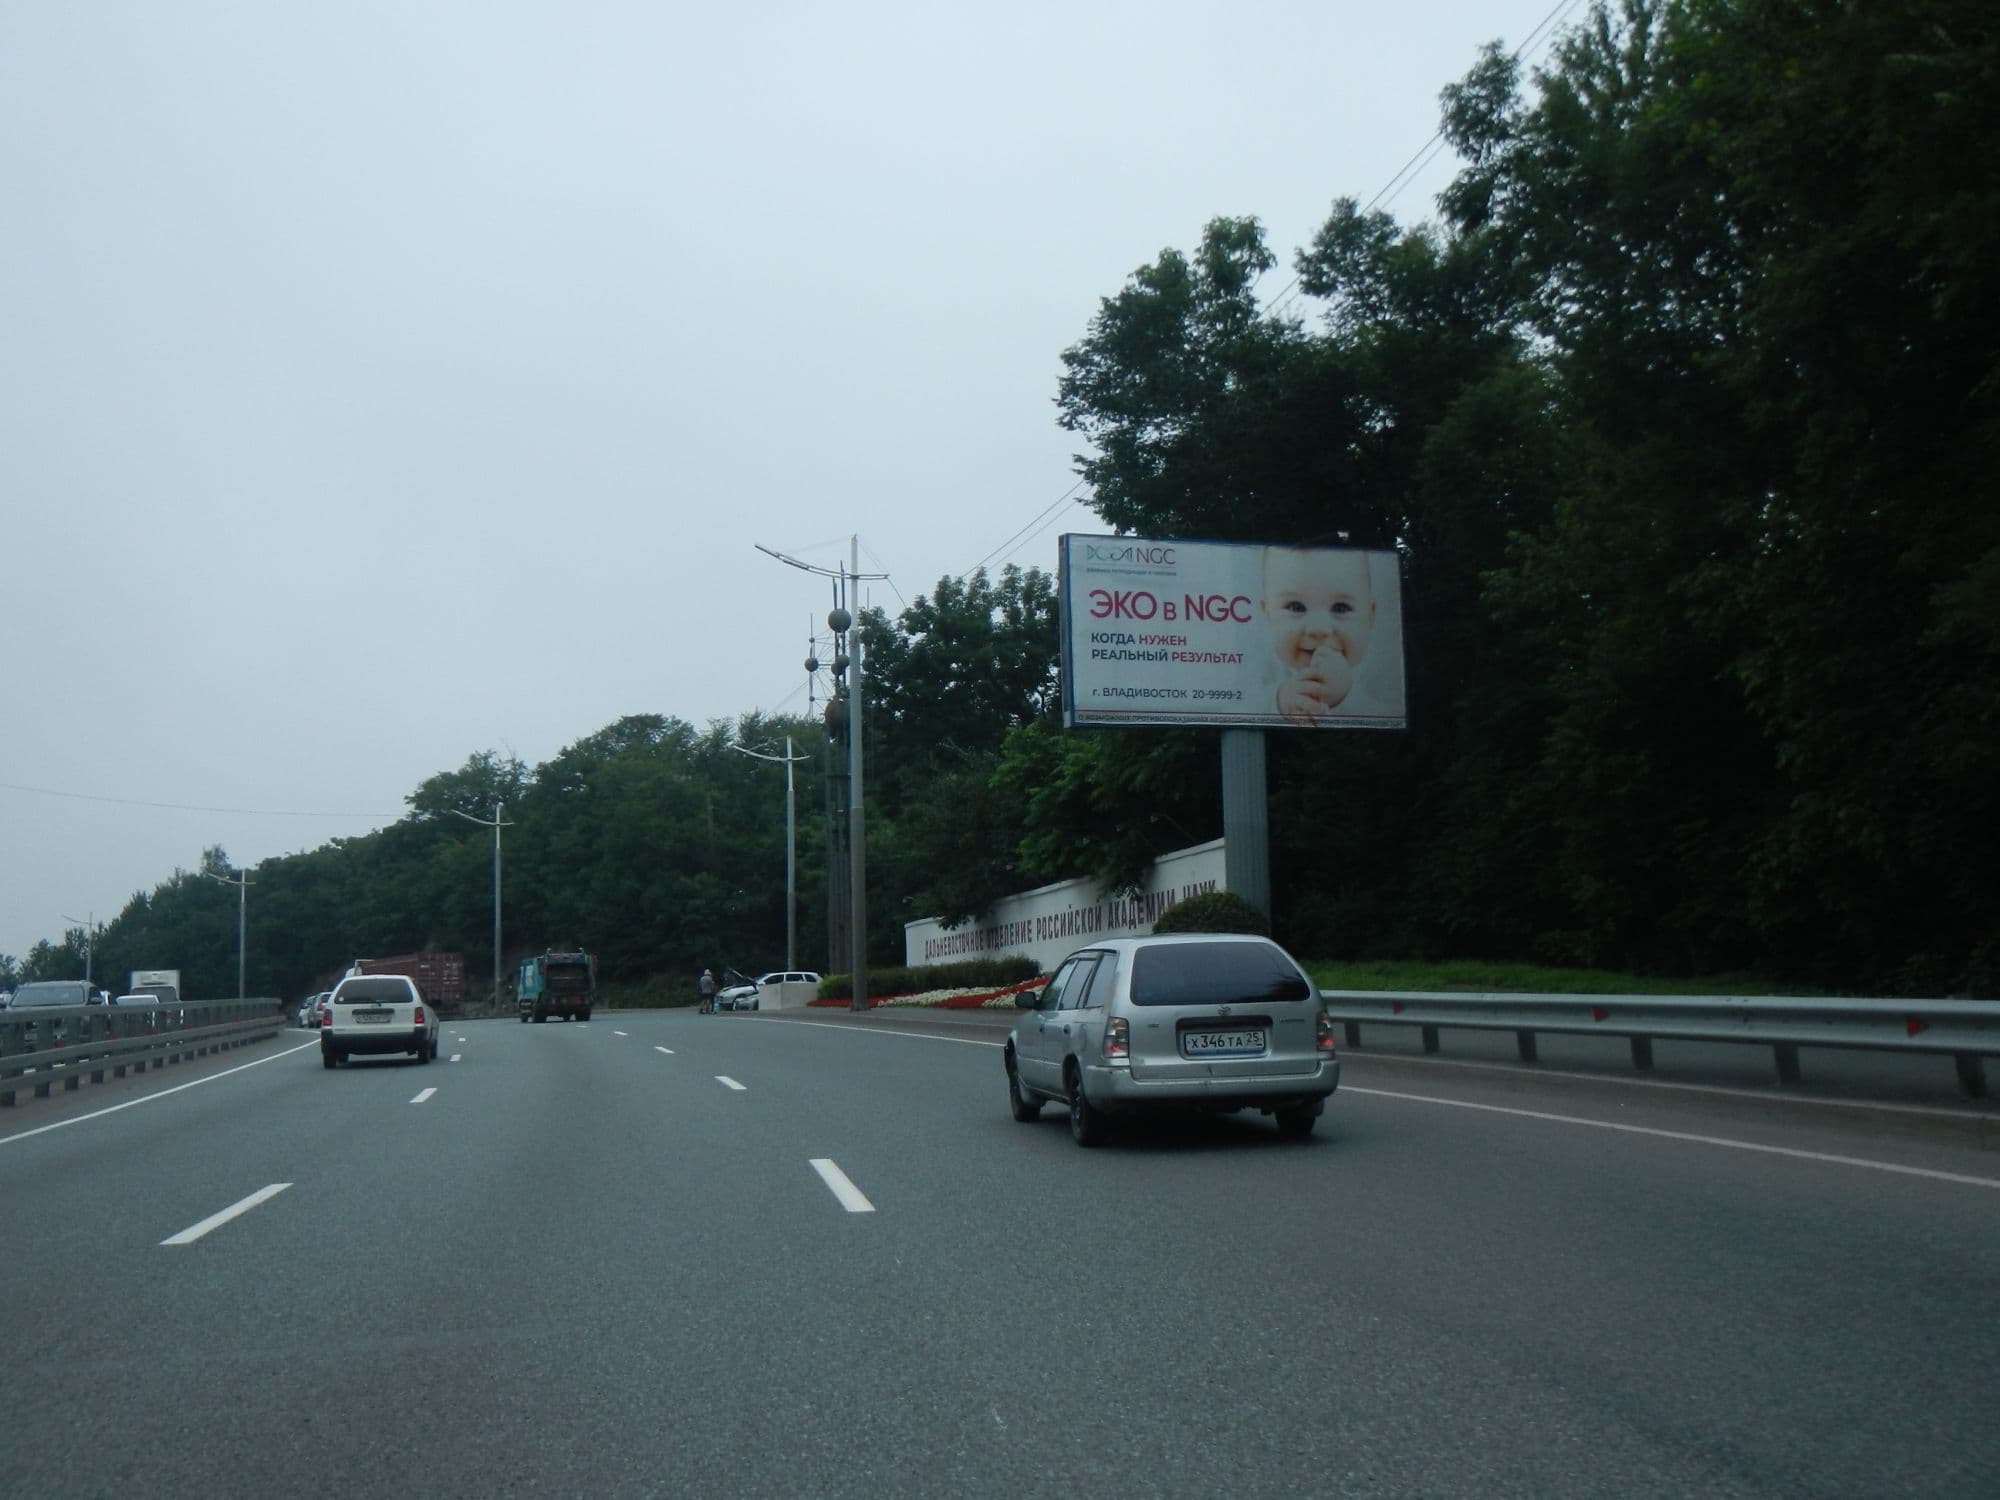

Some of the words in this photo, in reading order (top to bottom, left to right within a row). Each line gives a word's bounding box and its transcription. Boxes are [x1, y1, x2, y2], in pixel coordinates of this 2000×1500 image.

[1137, 547, 1176, 565] NGC
[1088, 589, 1157, 621] ЭКО
[1185, 594, 1252, 623] NGC
[1091, 633, 1135, 646] КОГДА
[1139, 634, 1187, 646] НУЖЕН
[1092, 649, 1168, 662] РЕАЛЬНЫЙ
[1172, 652, 1244, 664] РЕЗУЛЬТАТ
[1092, 689, 1100, 697] г.
[1103, 688, 1187, 699] ВЛАДИВОСТОК
[1192, 689, 1242, 700] 20-9999-2
[925, 928, 983, 960] ДАЛЬНЕВОСТОЧНОЕ
